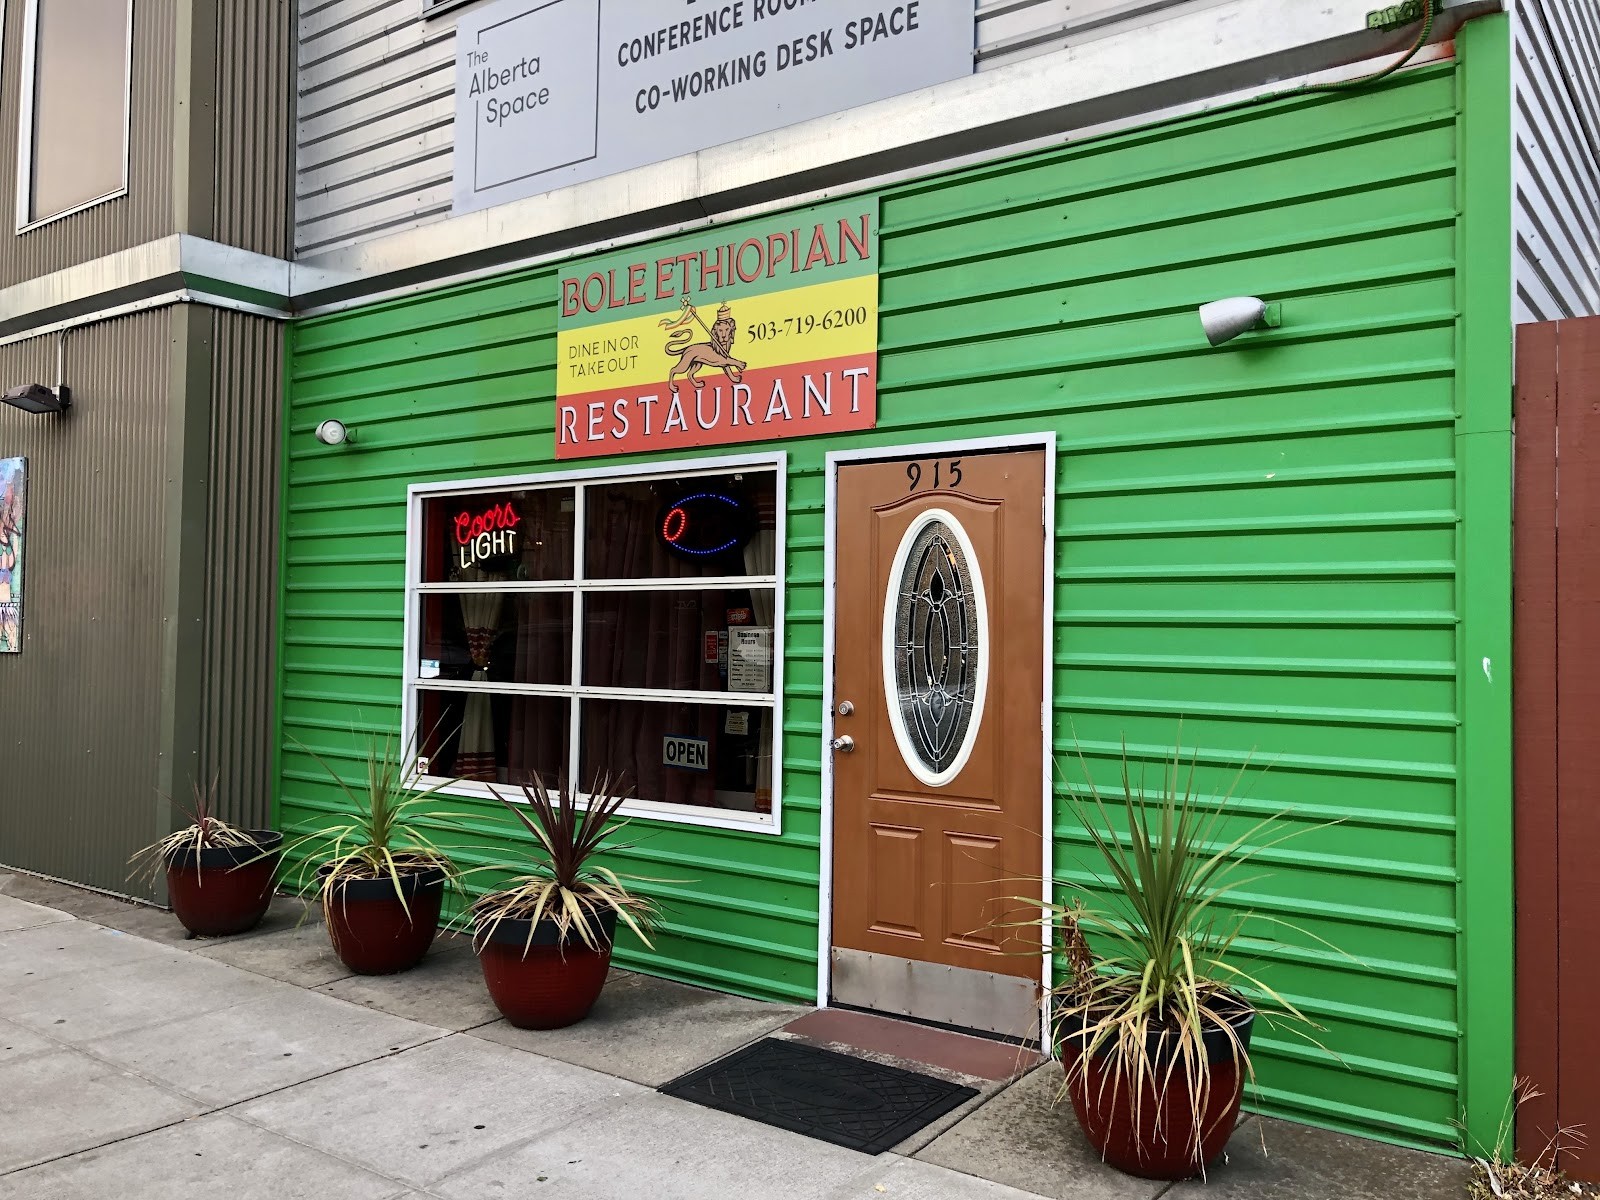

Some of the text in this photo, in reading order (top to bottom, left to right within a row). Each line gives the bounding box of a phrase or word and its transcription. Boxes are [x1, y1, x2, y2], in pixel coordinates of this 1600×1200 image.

[617, 0, 816, 67] CONFERENCE RO
[467, 51, 489, 68] The
[635, 1, 920, 114] CO-WORKING DESK SPACE
[469, 57, 540, 98] Alberta
[486, 87, 549, 127] Space
[562, 213, 871, 318] BOLE ETHIOPIAN
[747, 306, 867, 344] 503-719-6200
[569, 335, 639, 359] DINE IN OR
[569, 355, 638, 378] TAKE OUT
[559, 367, 869, 445] RESTAURANT
[907, 460, 962, 491] 915
[454, 502, 520, 544] Coors
[461, 530, 517, 569] LIGHT
[667, 741, 706, 765] OPEN
